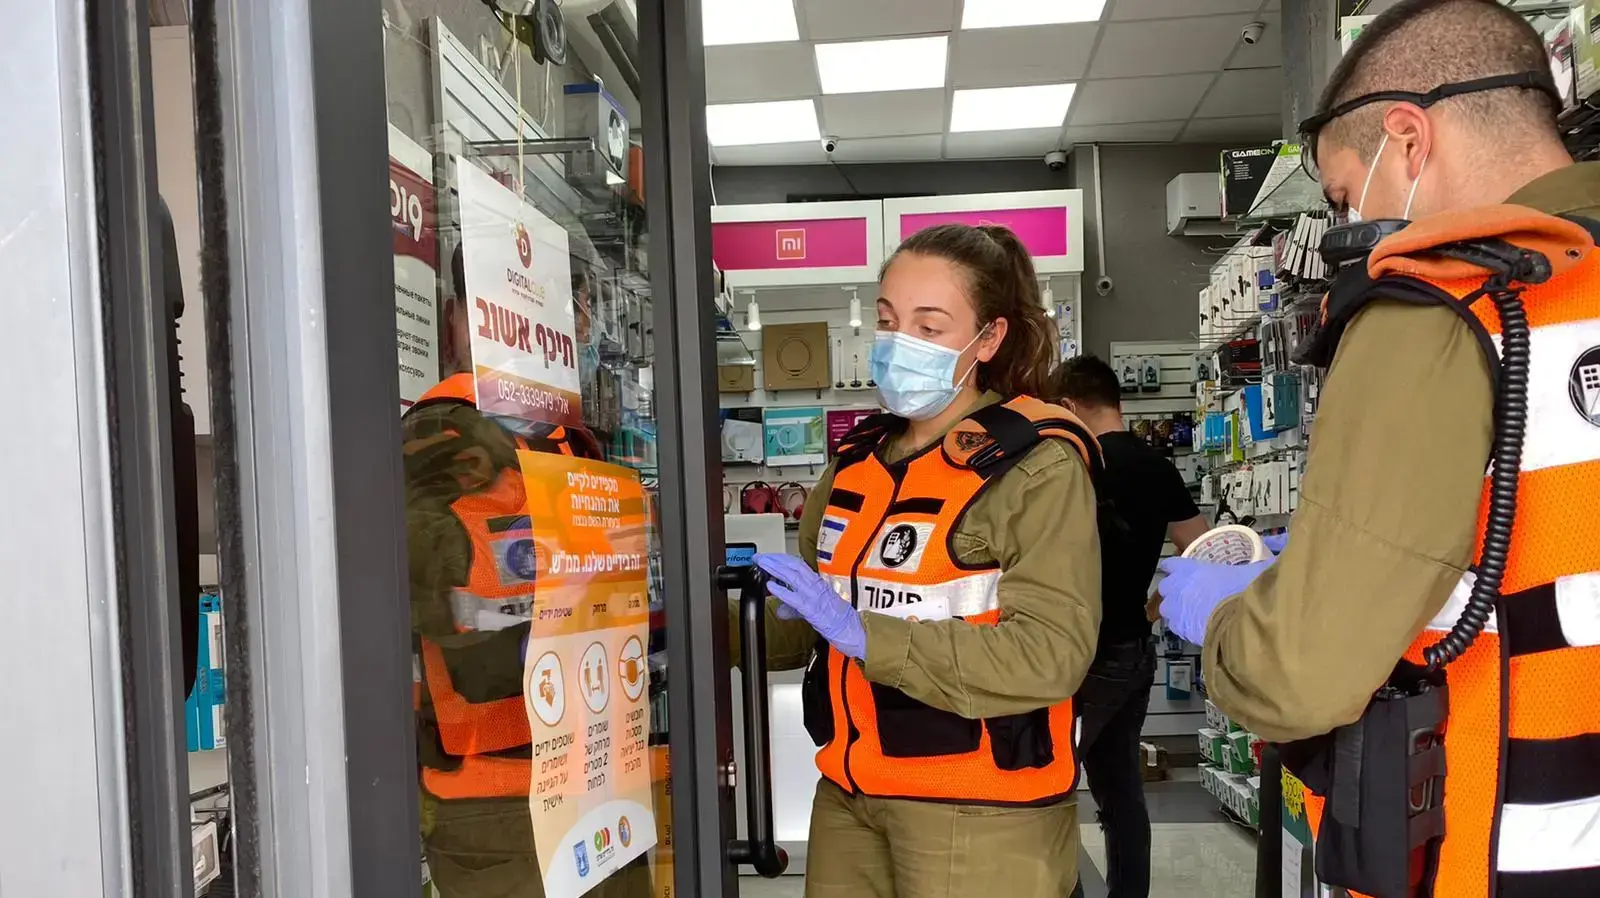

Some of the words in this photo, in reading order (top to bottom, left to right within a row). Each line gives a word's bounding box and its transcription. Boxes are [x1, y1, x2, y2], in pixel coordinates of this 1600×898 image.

[1232, 148, 1275, 158] GAMEON
[475, 296, 532, 354] אשוב
[535, 322, 575, 370] תיכף
[498, 378, 553, 411] 052-3339479
[608, 497, 620, 513] את
[606, 554, 630, 572] בידיים
[630, 554, 640, 570] זה
[603, 752, 608, 766] 2
